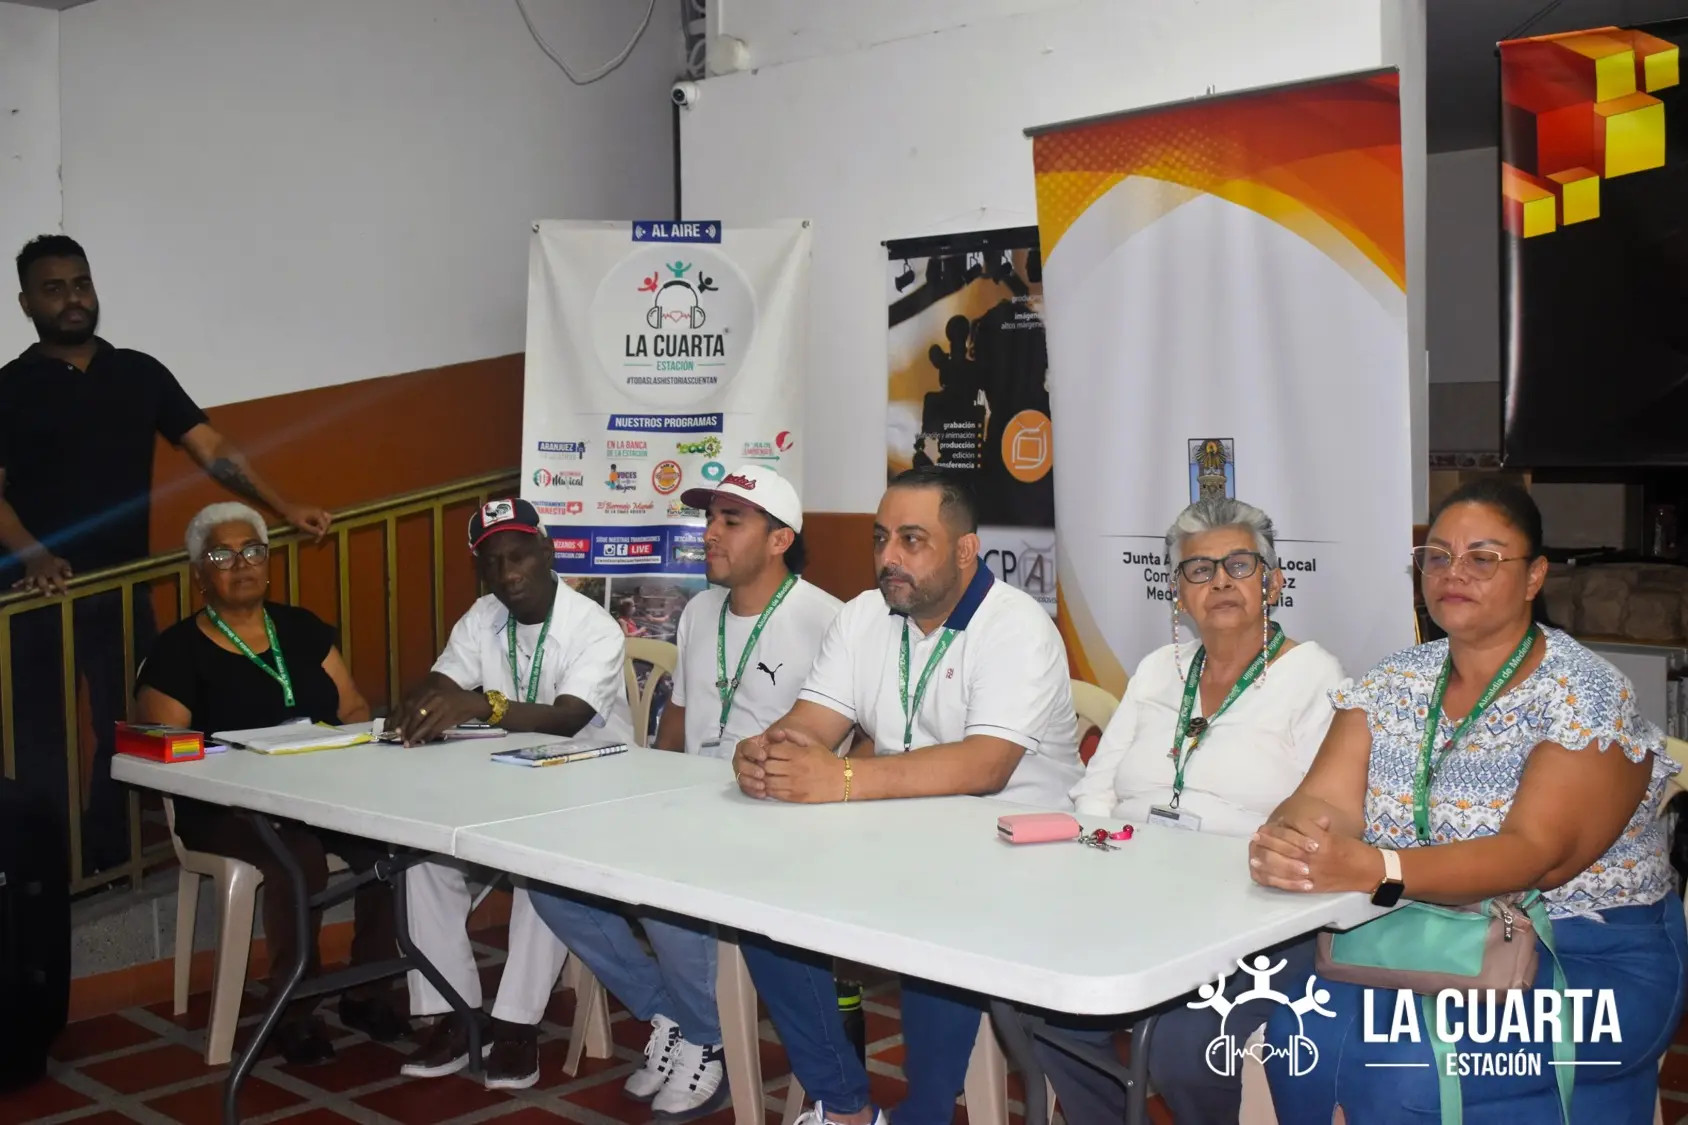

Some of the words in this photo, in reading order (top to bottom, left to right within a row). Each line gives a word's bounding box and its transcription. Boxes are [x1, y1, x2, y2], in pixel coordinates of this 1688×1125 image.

[651, 224, 669, 237] AL
[671, 224, 701, 237] AIRE
[625, 334, 648, 357] LA
[653, 334, 725, 357] CUARTA
[656, 360, 694, 371] ESTACIÓN
[626, 376, 718, 385] #TODASLASHISTORIASCUENTAN
[615, 417, 662, 428] NUESTROS
[664, 416, 717, 428] PROGRAMAS
[943, 421, 976, 431] grabación
[540, 442, 574, 451] ARANJUEZ
[607, 440, 616, 449] EN
[617, 441, 625, 449] LA
[626, 441, 647, 449] BANCA
[940, 441, 975, 450] producción
[952, 452, 975, 460] edición
[617, 471, 637, 479] VOCES
[631, 544, 650, 554] LIVE
[1123, 552, 1161, 565] Junta
[1278, 557, 1316, 571] Local
[757, 604, 775, 630] Alcaldía
[1478, 677, 1504, 709] Alcaldía
[1509, 636, 1534, 668] Medellín
